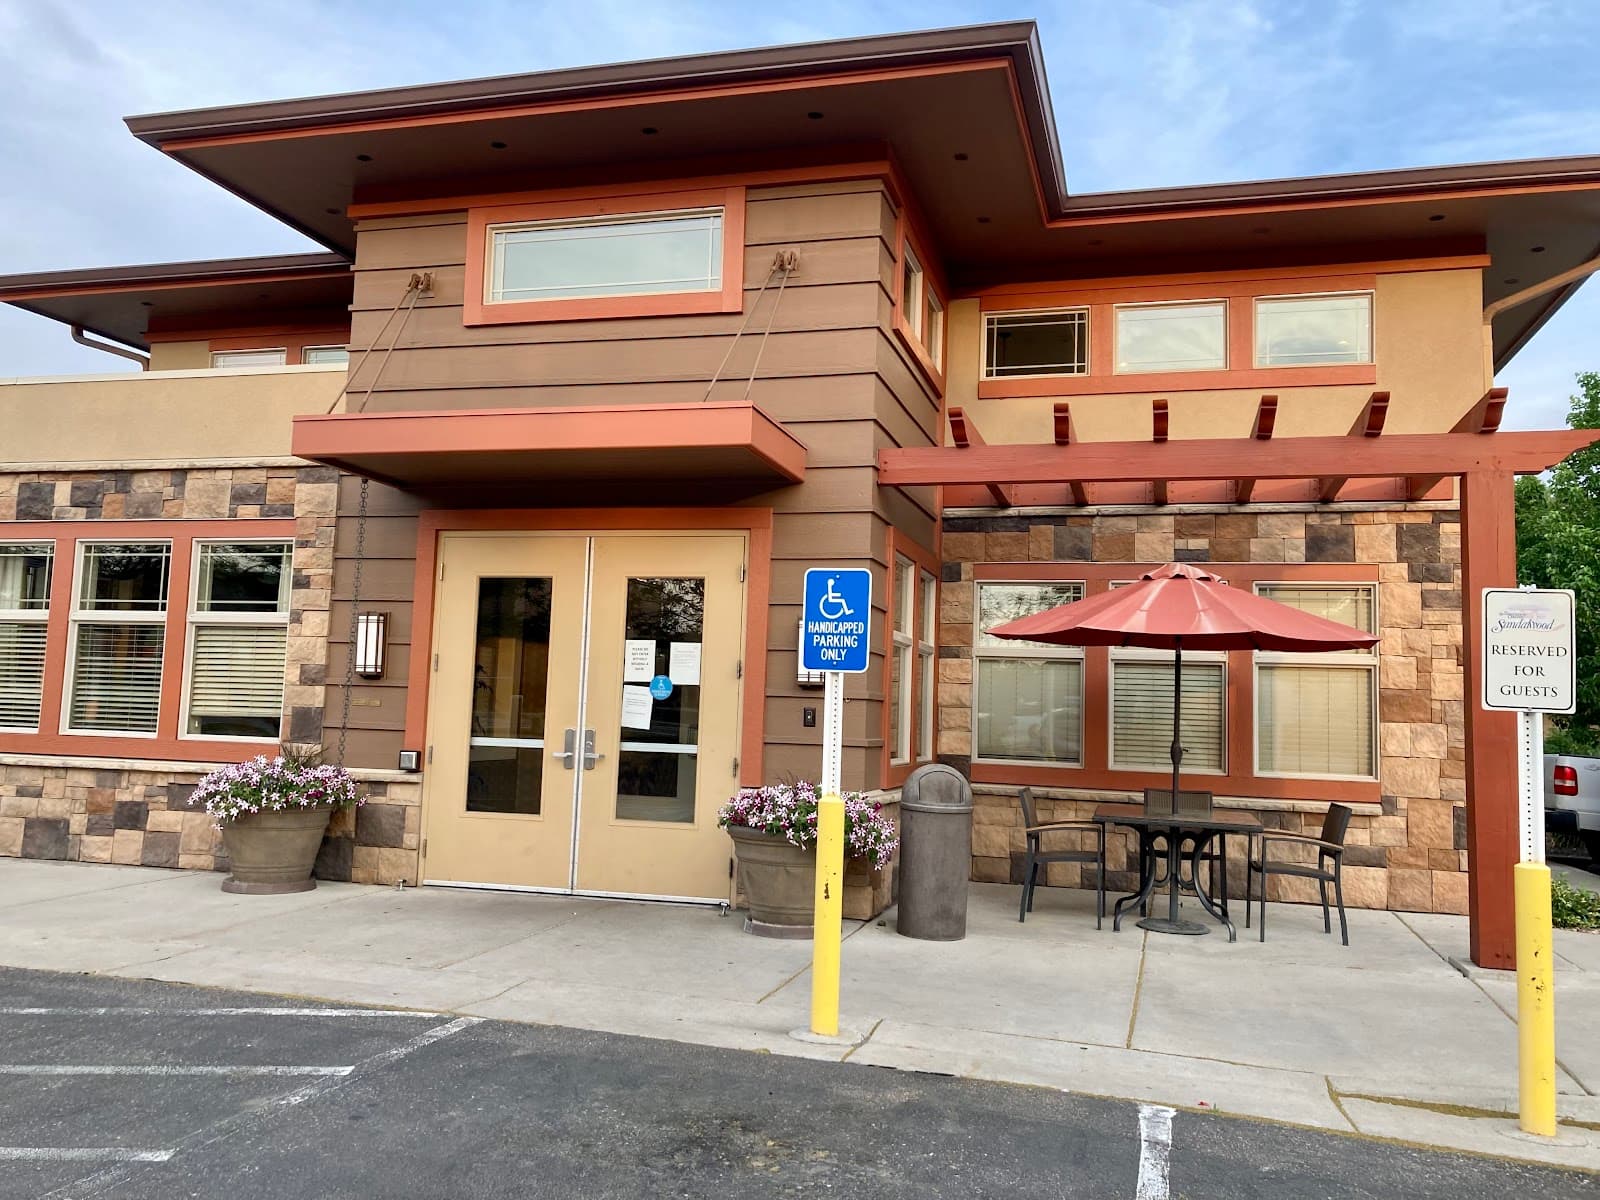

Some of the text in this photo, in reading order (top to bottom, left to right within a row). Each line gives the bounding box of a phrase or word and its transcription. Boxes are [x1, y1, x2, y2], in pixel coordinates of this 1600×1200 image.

[808, 621, 864, 634] HANDICAPPED
[813, 635, 858, 647] PARKING
[820, 648, 847, 660] ONLY
[1491, 644, 1568, 657] RESERVED
[1514, 665, 1545, 677] FOR
[1500, 684, 1558, 697] GUESTS
